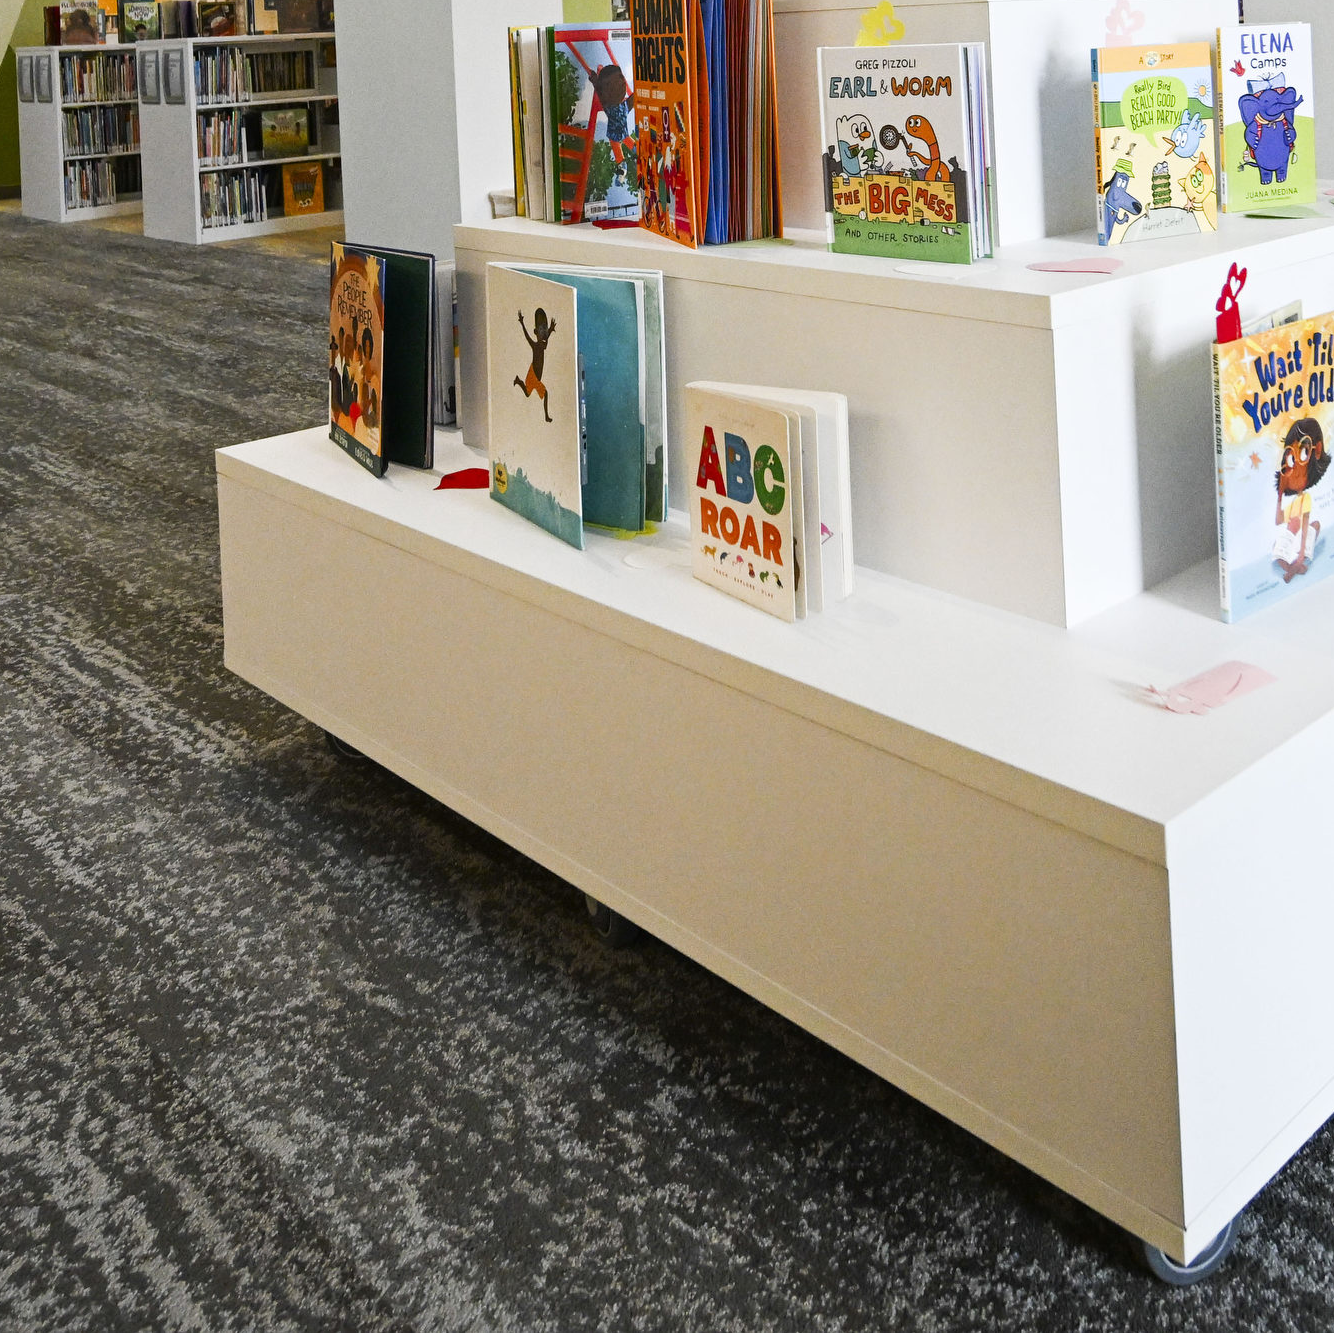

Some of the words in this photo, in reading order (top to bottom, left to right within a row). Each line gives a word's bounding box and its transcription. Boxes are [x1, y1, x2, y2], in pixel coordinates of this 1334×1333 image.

[1240, 32, 1294, 55] ELENA
[634, 36, 686, 84] RIGHTS
[855, 59, 879, 70] GREG
[882, 58, 917, 69] PIZZOLI
[1139, 56, 1144, 64] A
[1250, 57, 1287, 69] Camps
[829, 76, 877, 98] EARL
[879, 79, 889, 94] &
[891, 75, 953, 97] WORM
[1133, 79, 1154, 95] Really
[1157, 79, 1172, 92] Bird
[1130, 93, 1154, 113] REALLY
[1157, 92, 1176, 108] GOOD
[1130, 110, 1154, 130] BEACH
[1156, 109, 1182, 126] PARTY!
[834, 189, 861, 206] THE
[868, 183, 911, 216] BIG
[914, 187, 954, 222] MESS
[1245, 190, 1269, 200] JUANA
[1271, 187, 1299, 197] MEDINA
[845, 228, 862, 238] AND
[867, 233, 898, 242] OTHER
[902, 233, 939, 243] STORIES
[349, 273, 360, 288] THE
[343, 281, 367, 308] PEOPLE
[1254, 340, 1302, 392] Wait
[1307, 332, 1333, 366] 'Til
[1242, 382, 1303, 433] You're
[696, 425, 786, 515] ABC
[700, 496, 784, 567] ROAR
